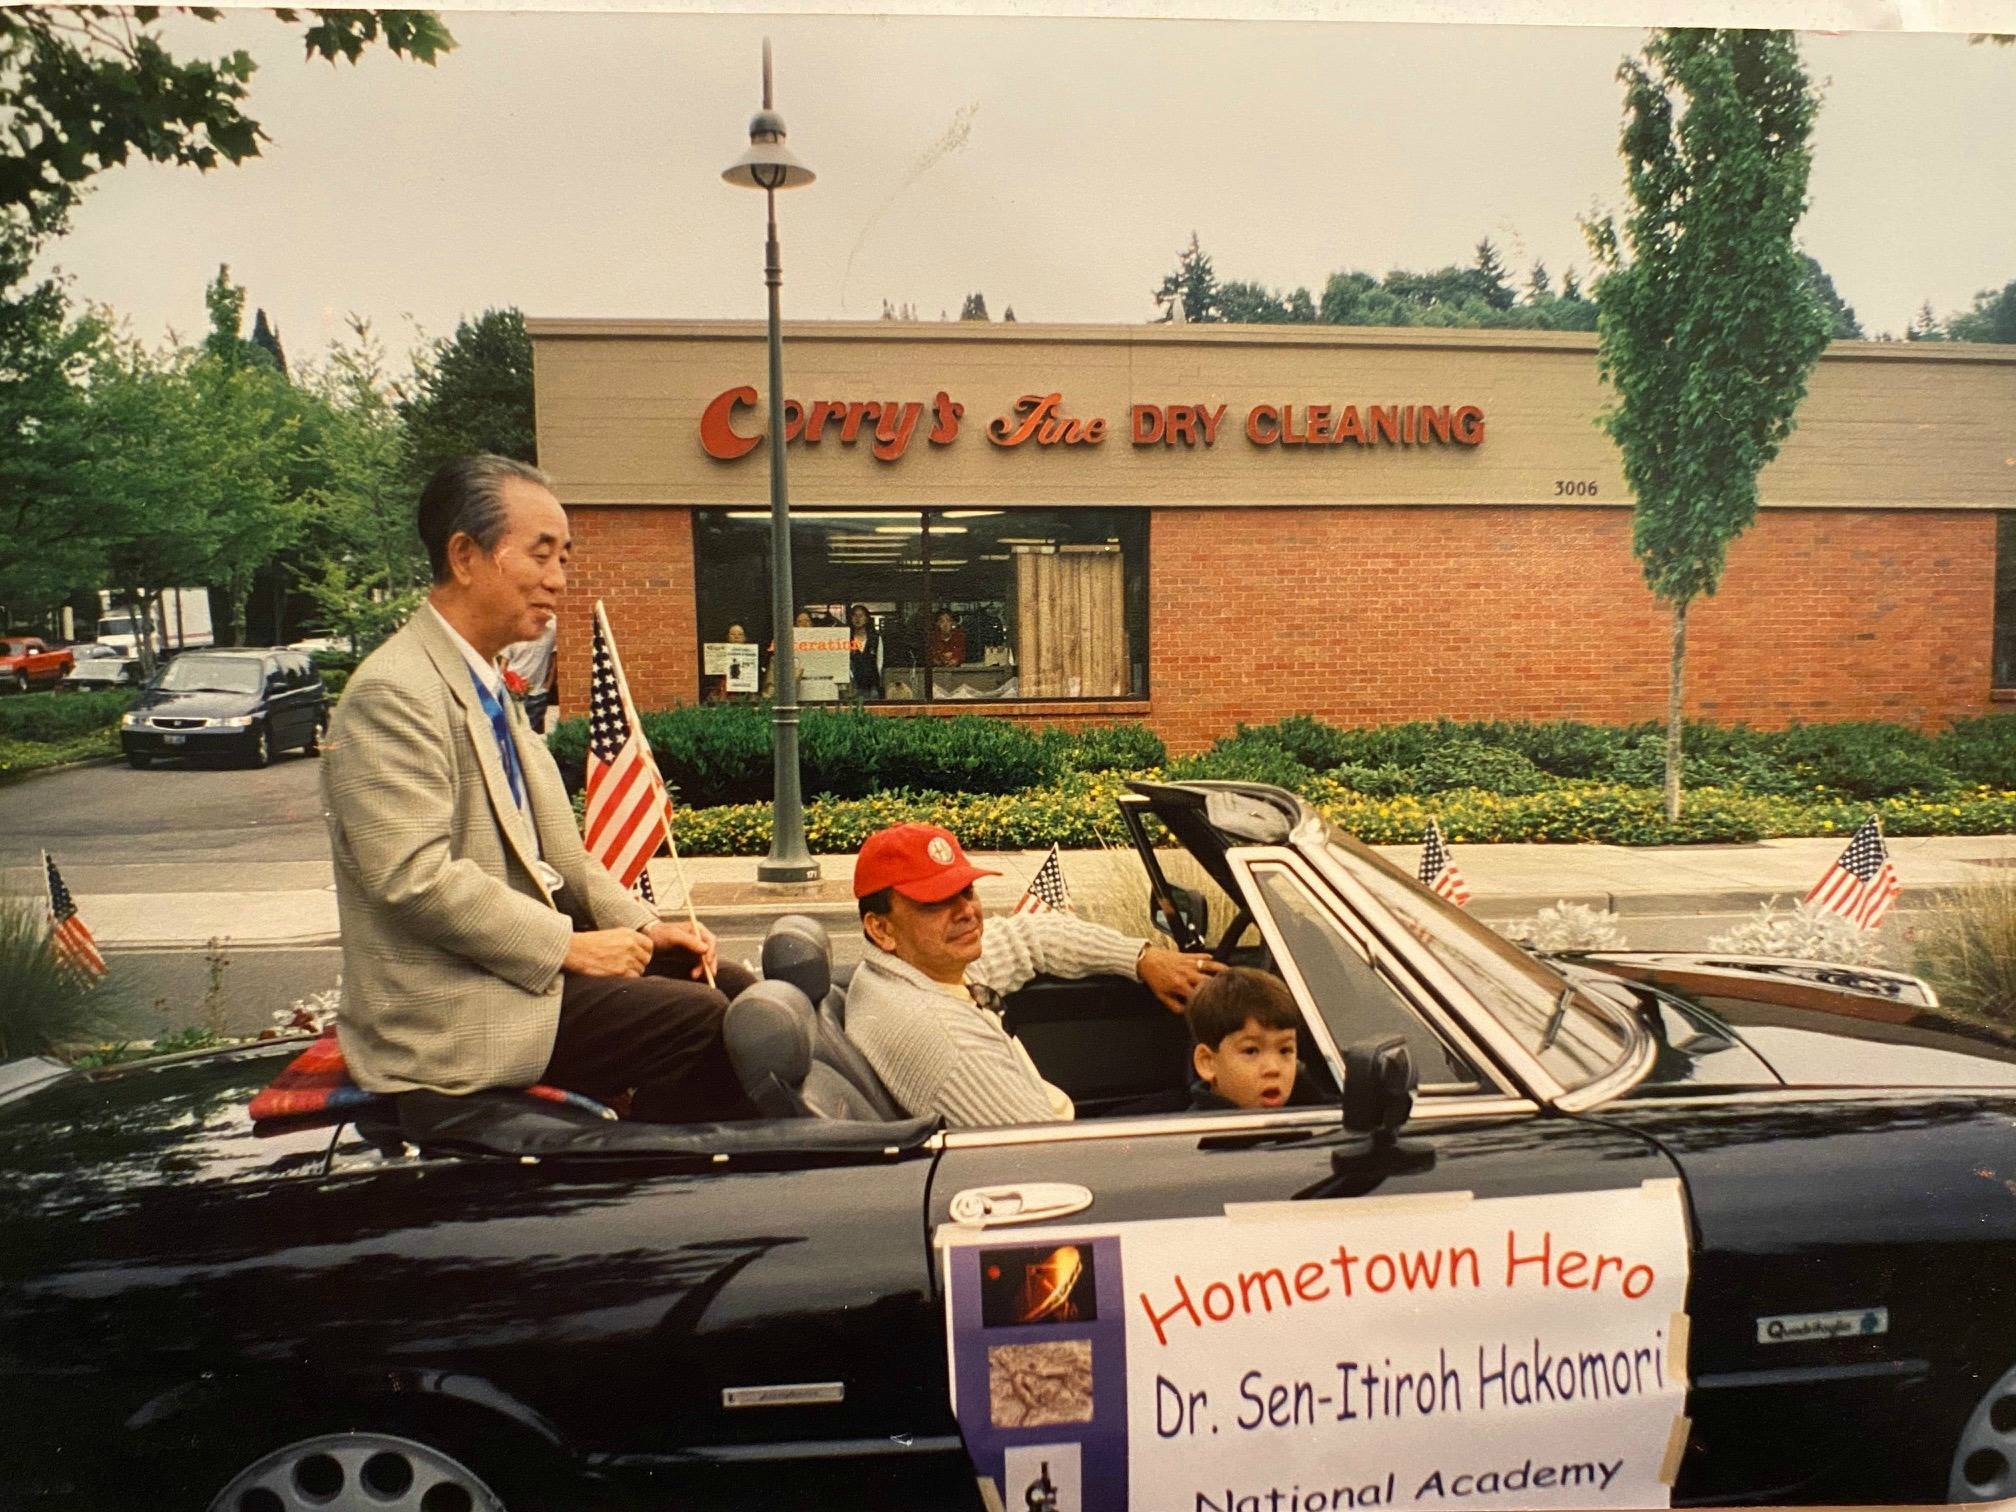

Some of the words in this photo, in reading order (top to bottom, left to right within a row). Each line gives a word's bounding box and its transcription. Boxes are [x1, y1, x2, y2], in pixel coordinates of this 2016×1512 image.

[986, 392, 1106, 448] Fine
[1131, 403, 1226, 447] DRY
[1246, 404, 1485, 448] CLEANING
[1556, 480, 1598, 496] 3006
[1140, 1244, 1481, 1346] Hometown
[1505, 1230, 1656, 1301] Hero
[1156, 1374, 1219, 1438] Dr.
[1237, 1347, 1461, 1431] Sen-Itiroh
[1479, 1330, 1664, 1409] Hakomori
[1195, 1472, 1396, 1512] National
[1414, 1458, 1624, 1502] Academy
